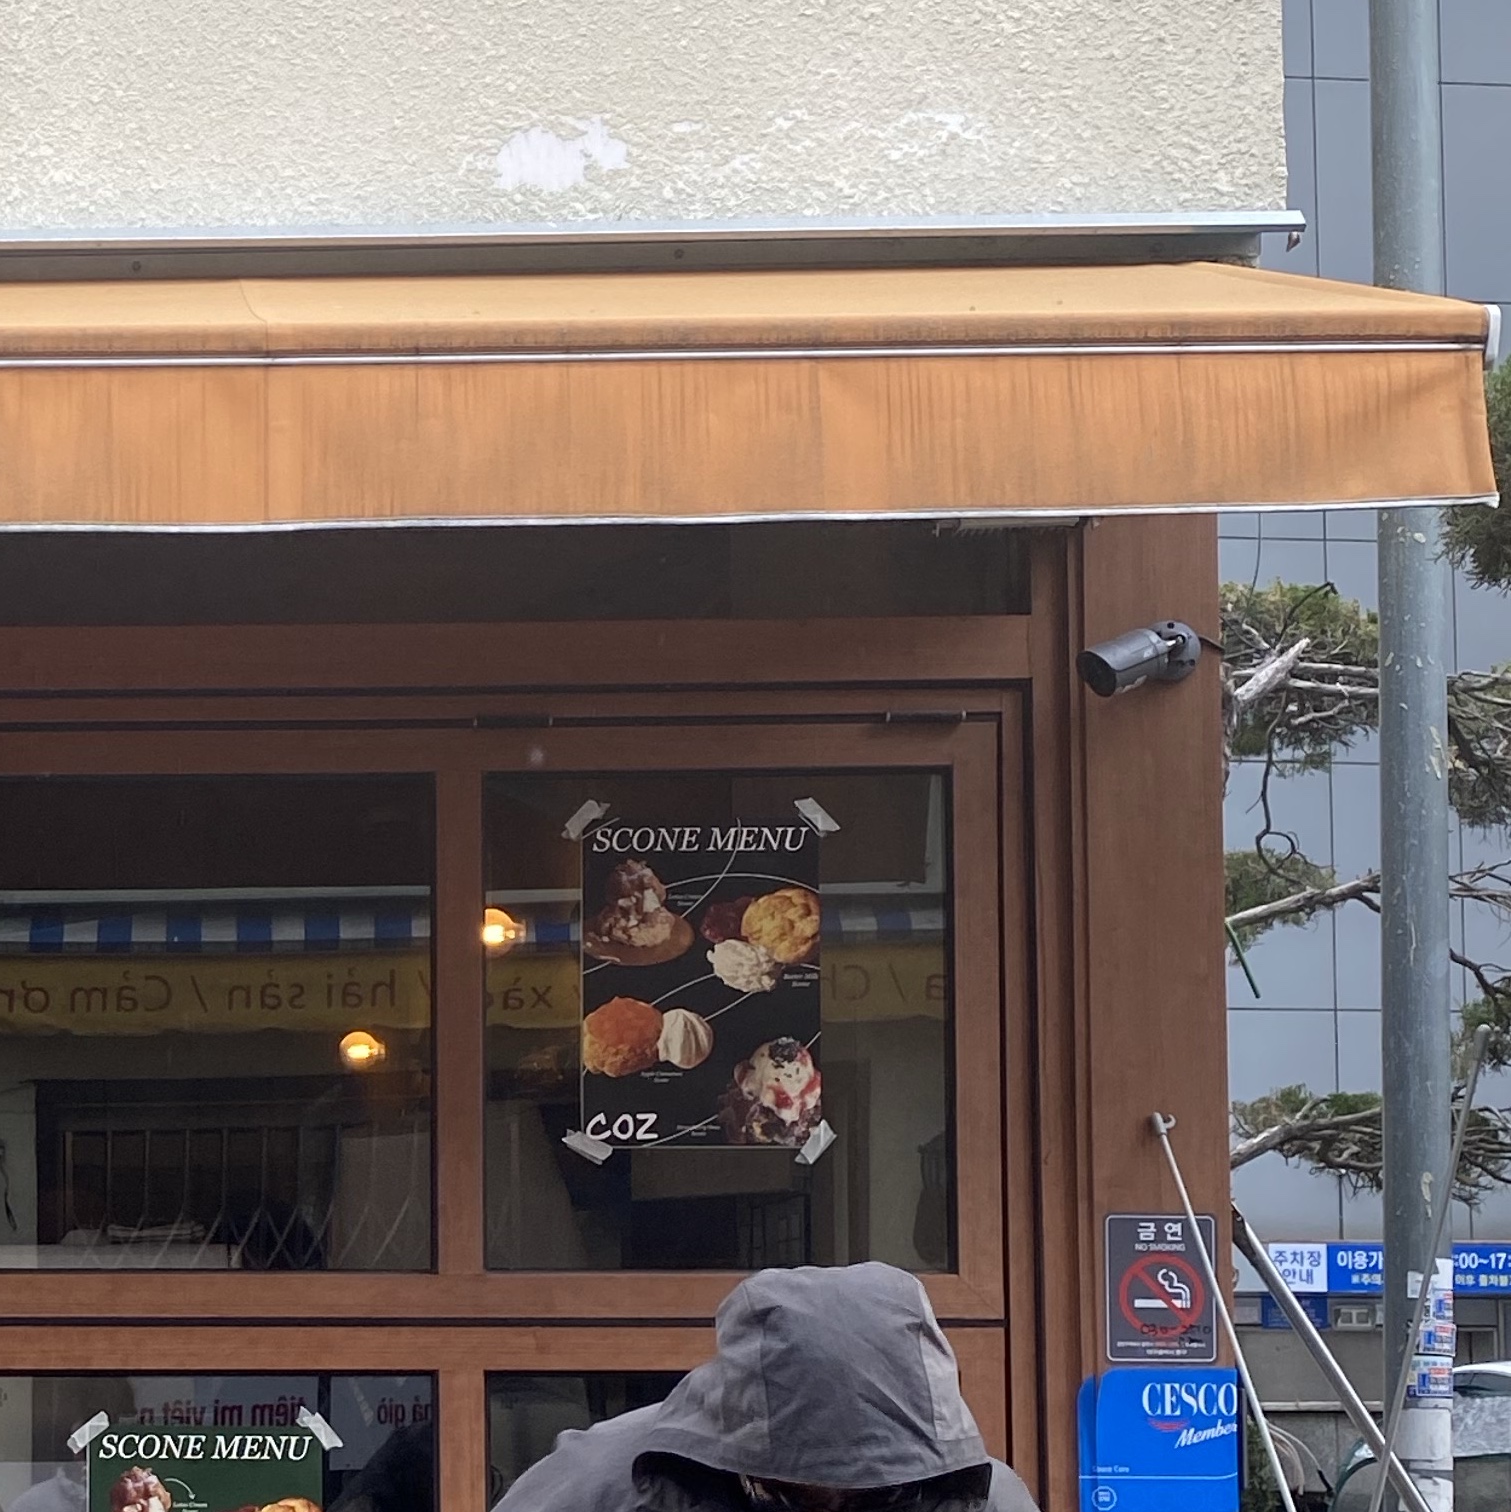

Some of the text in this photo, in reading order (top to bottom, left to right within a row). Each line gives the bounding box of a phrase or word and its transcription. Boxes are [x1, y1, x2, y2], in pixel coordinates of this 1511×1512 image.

[592, 826, 809, 853] SCONE MENU
[586, 1112, 659, 1141] COZ
[1273, 1250, 1321, 1267] 주차장
[1282, 1268, 1314, 1285] 안내
[1142, 1382, 1237, 1417] CESCO
[98, 1434, 312, 1460] SCONE MENU
